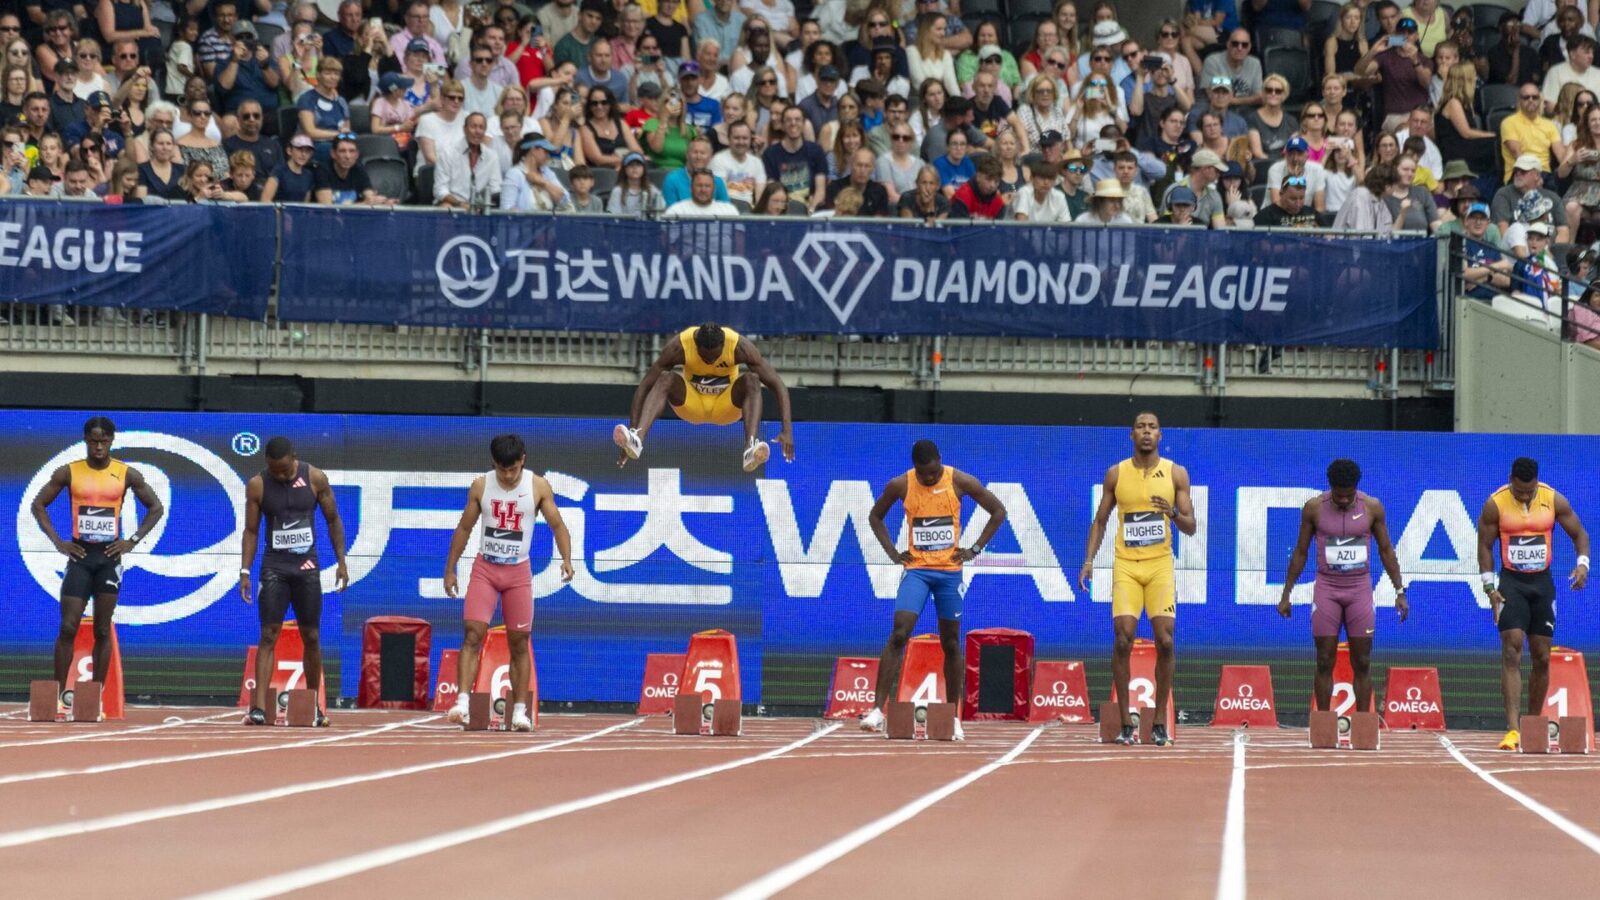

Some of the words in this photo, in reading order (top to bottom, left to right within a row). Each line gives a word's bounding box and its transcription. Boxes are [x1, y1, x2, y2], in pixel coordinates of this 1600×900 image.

[505, 249, 609, 302] 万达
[611, 253, 795, 302] WANDA
[891, 258, 1101, 305] DIAMOND
[1111, 264, 1292, 312] LEAGUE
[85, 520, 114, 532] BLAKE
[1125, 525, 1164, 538] HUGHES
[274, 531, 312, 546] SIMBINE
[914, 530, 953, 542] TEBOGO
[484, 541, 520, 556] HINCHLIFFE
[1336, 550, 1357, 561] AZU
[1510, 550, 1516, 560] Y
[1517, 549, 1546, 560] BLAKE
[277, 661, 304, 691] 7
[644, 686, 680, 698] OME
[694, 669, 722, 704] 5
[911, 672, 941, 707] 4
[835, 689, 876, 703] OMEG
[1033, 694, 1086, 708] OMEGA
[1128, 678, 1156, 711] 3
[1332, 682, 1356, 717] 2
[1219, 697, 1271, 711] OMEGA
[1388, 700, 1440, 713] OMEGA
[1547, 687, 1568, 718] 1
